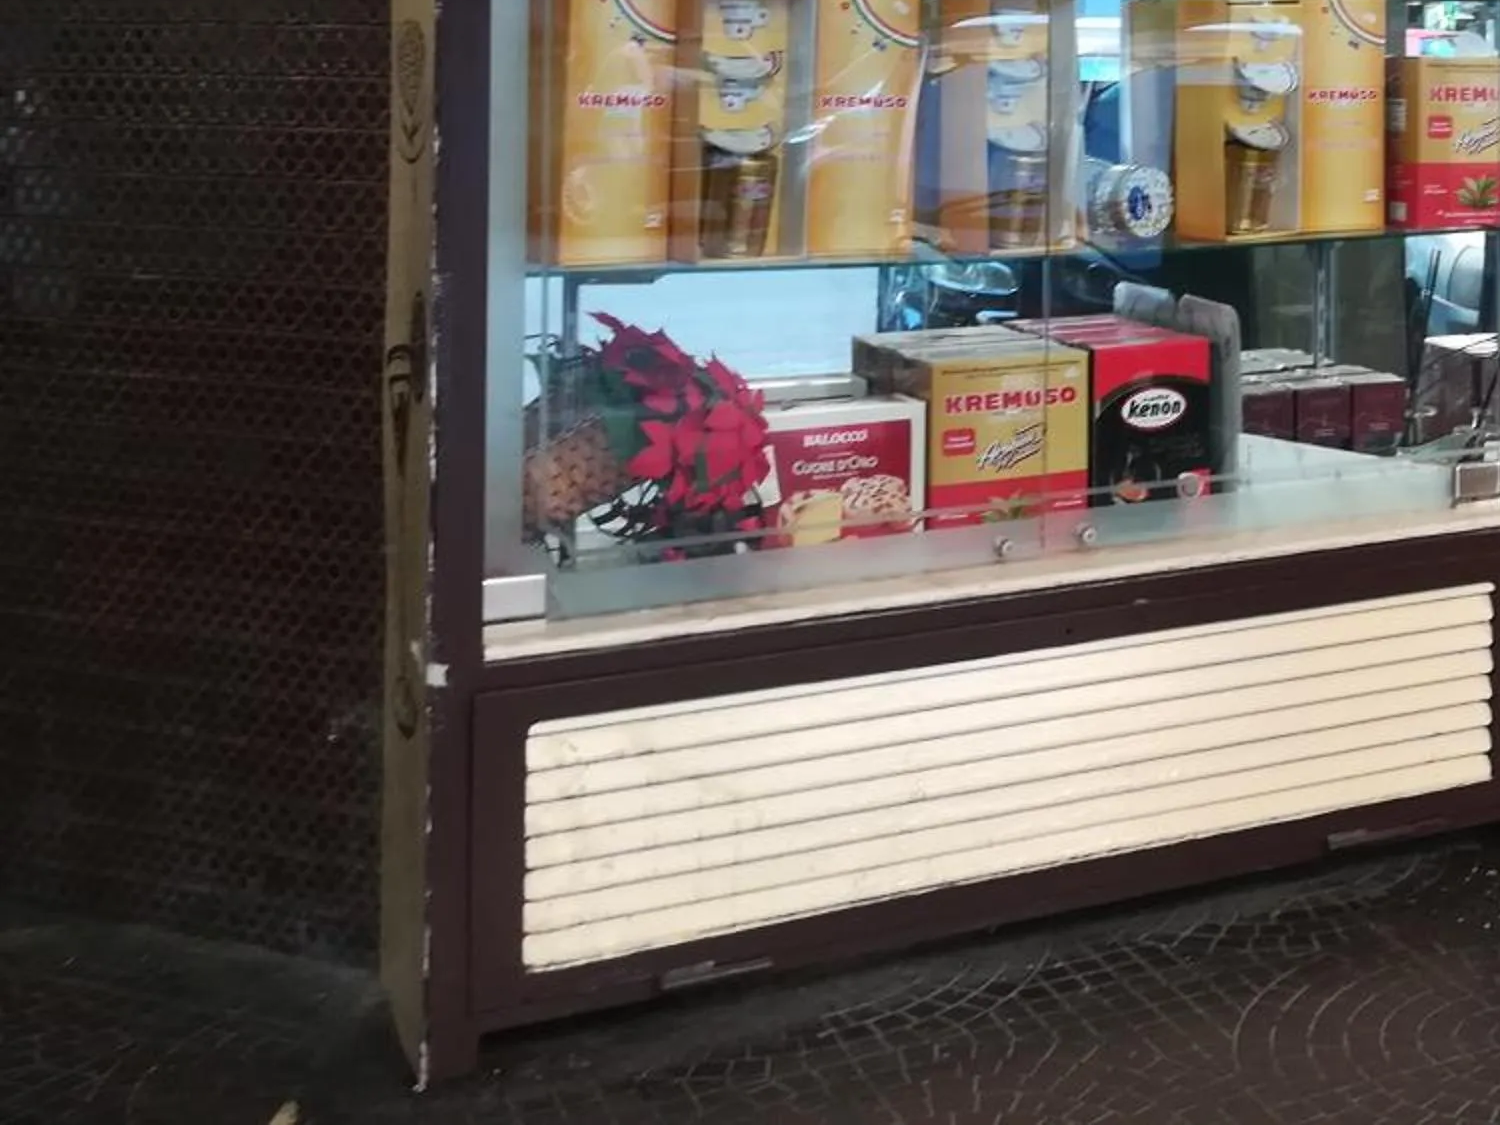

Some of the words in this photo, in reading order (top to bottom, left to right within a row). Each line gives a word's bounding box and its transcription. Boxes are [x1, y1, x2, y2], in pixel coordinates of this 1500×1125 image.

[944, 385, 1077, 415] KREMUSO
[1126, 398, 1182, 418] kenon
[803, 429, 868, 448] BALOCCO
